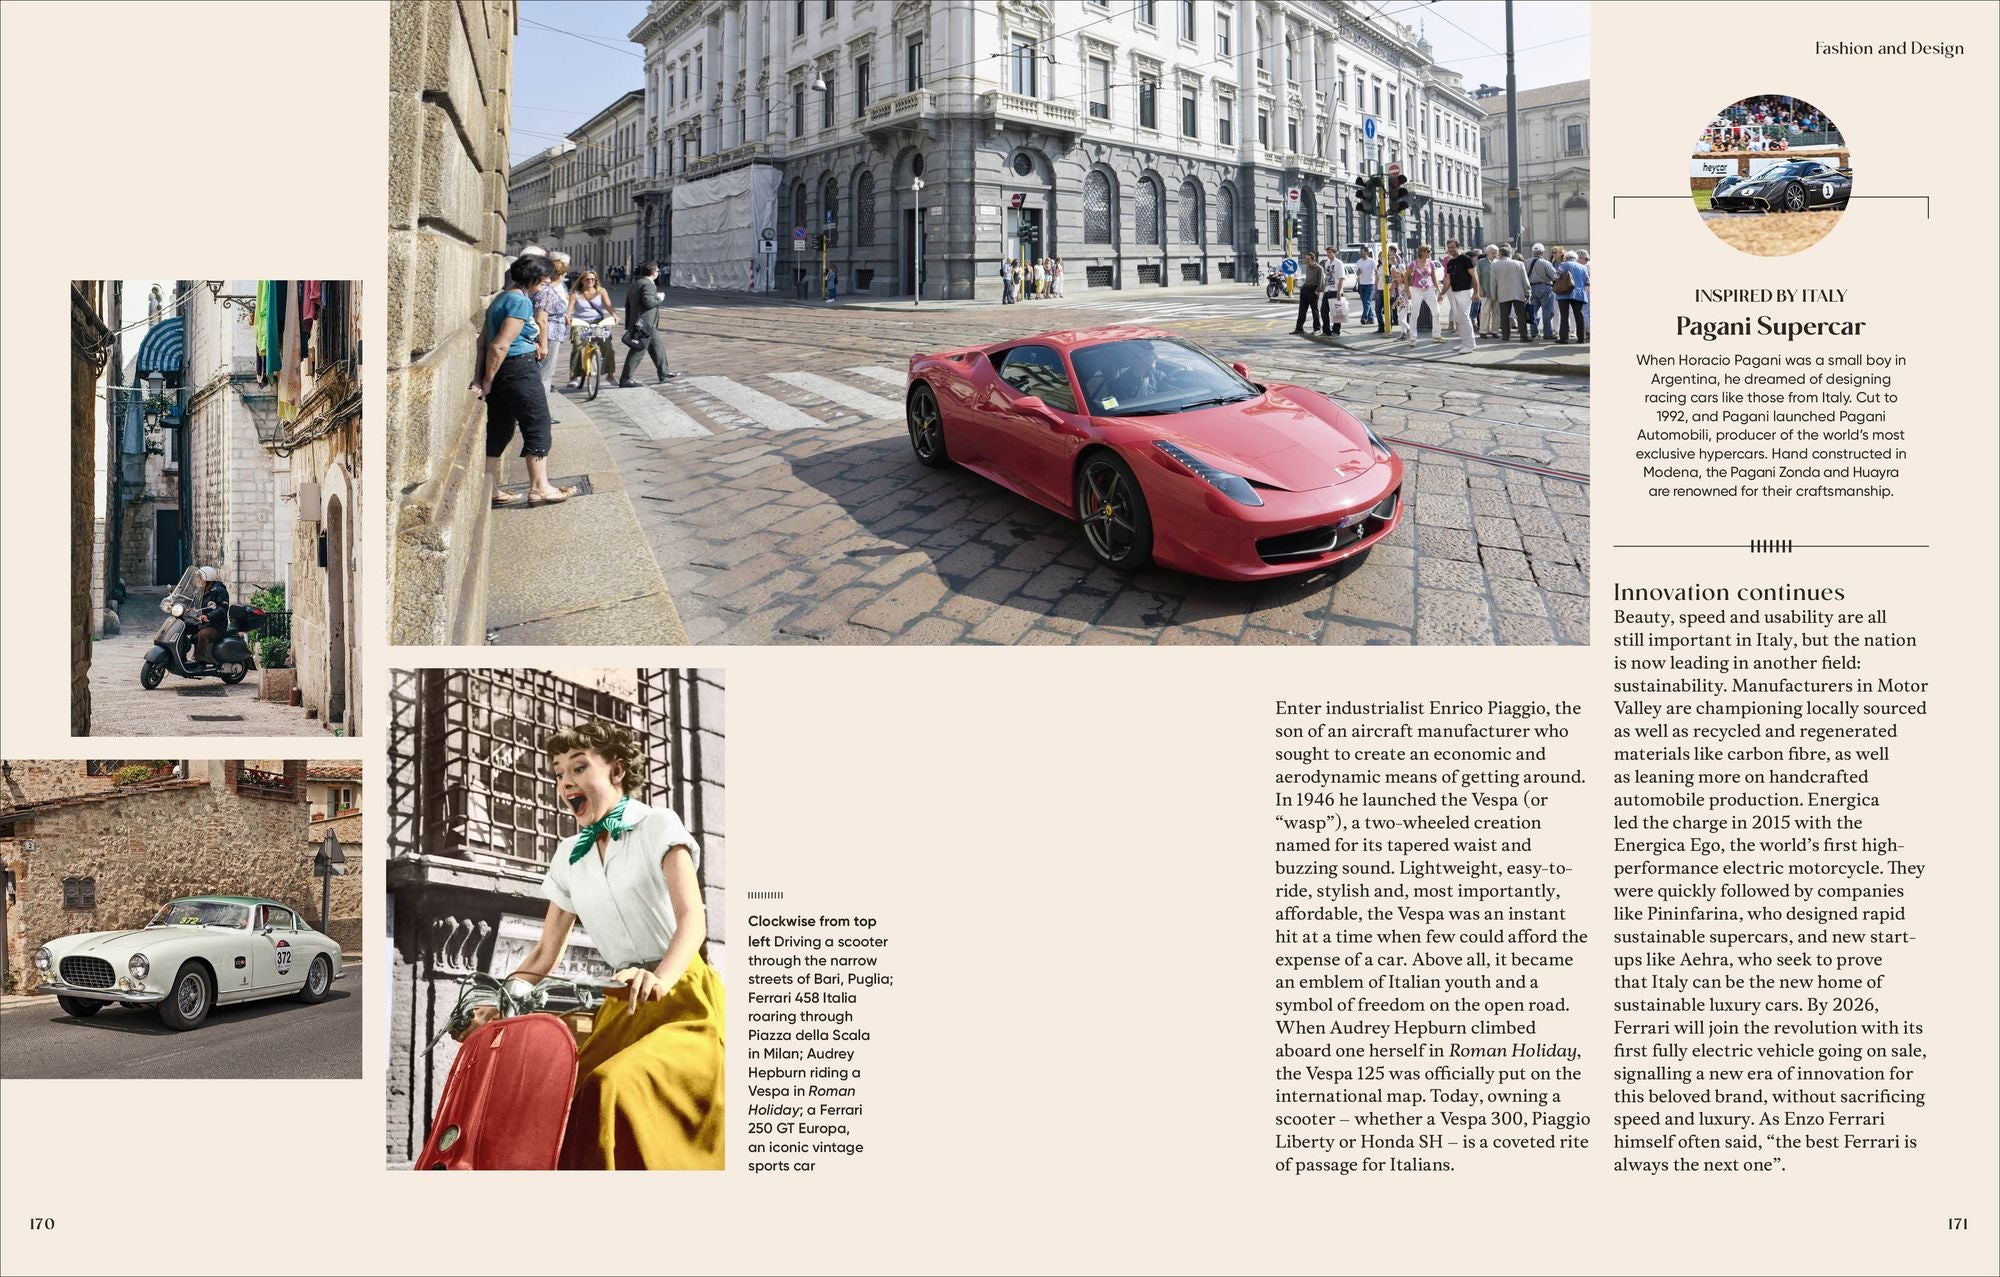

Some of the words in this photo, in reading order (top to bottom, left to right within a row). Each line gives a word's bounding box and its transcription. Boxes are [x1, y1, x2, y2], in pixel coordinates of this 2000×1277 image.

[1816, 41, 1873, 55] Fashion
[1878, 41, 1906, 54] and
[1911, 41, 1964, 58] Design
[1703, 162, 1728, 174] heycar
[1696, 289, 1773, 302] INSPIRED
[1777, 289, 1797, 302] BY
[1803, 289, 1847, 302] ITALY
[1677, 316, 1751, 341] Pagani
[1757, 315, 1866, 341] Supercar
[1636, 354, 1675, 366] When
[1679, 354, 1730, 366] Horacio
[1735, 354, 1781, 369] Pagani
[1785, 357, 1812, 366] was
[1815, 357, 1824, 366] a
[1828, 354, 1862, 366] small
[1866, 354, 1892, 368] boy
[1895, 354, 1906, 365] in
[1651, 373, 1720, 388] Argentina,
[1725, 373, 1741, 385] he
[1744, 373, 1805, 385] dreamed
[1809, 373, 1823, 384] of
[1826, 373, 1891, 388] designing
[1645, 392, 1686, 406] racing
[1690, 394, 1718, 403] cars
[1722, 391, 1744, 403] like
[1747, 392, 1785, 403] those
[1788, 391, 1818, 403] from
[1822, 391, 1852, 406] Italy.
[1856, 391, 1880, 403] Cut
[1884, 393, 1898, 403] to
[1656, 410, 1688, 424] 1992,
[1692, 411, 1718, 422] and
[1723, 410, 1769, 425] Pagani
[1773, 410, 1835, 422] launched
[1840, 410, 1885, 425] Pagani
[1637, 428, 1712, 442] Automobili,
[1716, 429, 1776, 443] producer
[1780, 429, 1794, 440] of
[1797, 429, 1819, 440] the
[1823, 429, 1869, 440] world’s
[1872, 430, 1905, 440] most
[1636, 448, 1695, 459] exclusive
[1699, 448, 1768, 462] hypercars.
[1772, 448, 1808, 459] Hand
[1812, 448, 1891, 459] constructed
[1896, 448, 1906, 459] in
[1644, 466, 1701, 479] Modena,
[1706, 466, 1727, 478] the
[1731, 466, 1775, 481] Pagani
[1779, 466, 1820, 478] Zonda
[1823, 466, 1849, 478] and
[1853, 466, 1899, 480] Huayra
[1649, 488, 1670, 497] are
[1673, 485, 1737, 497] renowned
[1741, 485, 1759, 497] for
[1762, 485, 1792, 497] their
[1796, 485, 1894, 499] craftsmanship.
[1615, 583, 1729, 601] Innovation
[1737, 583, 1845, 601] continues
[1614, 610, 1675, 628] Beauty,
[1679, 609, 1726, 628] speed
[1730, 610, 1760, 624] and
[1764, 609, 1834, 628] usability
[1838, 614, 1863, 624] are
[1868, 609, 1887, 624] all
[1614, 632, 1644, 646] still
[1649, 633, 1732, 651] important
[1736, 633, 1752, 646] in
[1756, 632, 1797, 651] Italy,
[1802, 632, 1829, 646] but
[1834, 632, 1859, 646] the
[1864, 633, 1917, 647] nation
[1614, 656, 1627, 669] is
[1631, 660, 1666, 669] now
[1670, 655, 1729, 674] leading
[1733, 656, 1749, 669] in
[1753, 655, 1818, 669] another
[1822, 655, 1861, 669] field:
[1276, 701, 1322, 715] Enter
[1326, 701, 1424, 715] industrialist
[1430, 701, 1483, 715] Enrico
[1488, 701, 1550, 719] Piaggio,
[1555, 701, 1581, 715] the
[1276, 728, 1303, 738] son
[1308, 723, 1326, 738] of
[1328, 728, 1347, 738] an
[1352, 723, 1413, 738] aircraft
[1418, 723, 1530, 738] manufacturer
[1534, 723, 1568, 738] who
[1276, 746, 1329, 765] sought
[1334, 749, 1350, 760] to
[1354, 749, 1406, 760] create
[1410, 751, 1429, 760] an
[1434, 747, 1511, 760] economic
[1516, 747, 1546, 760] and
[1275, 769, 1381, 788] aerodynamic
[1385, 774, 1437, 783] means
[1442, 769, 1460, 783] of
[1461, 770, 1520, 788] getting
[1523, 769, 1585, 783] around.
[748, 915, 816, 927] Clockwise
[819, 915, 850, 927] from
[853, 916, 877, 929] top
[748, 935, 771, 947] left
[774, 936, 821, 950] Driving
[825, 938, 834, 947] a
[838, 937, 888, 947] scooter
[277, 951, 291, 964] 372
[748, 955, 801, 969] through
[804, 955, 827, 966] the
[831, 957, 877, 966] narrow
[748, 974, 793, 984] streets
[797, 973, 811, 984] of
[814, 973, 844, 986] Bari,
[848, 973, 893, 987] Puglia;
[749, 992, 791, 1003] Ferrari
[795, 992, 819, 1003] 458
[823, 992, 856, 1003] Italia
[748, 1010, 796, 1025] roaring
[800, 1010, 853, 1025] through
[749, 1029, 791, 1041] Piazza
[795, 1029, 829, 1041] della
[832, 1029, 870, 1041] Scala
[748, 1048, 760, 1059] in
[764, 1047, 803, 1061] Milan;
[807, 1048, 854, 1062] Audrey
[749, 1067, 806, 1081] Hepburn
[810, 1067, 848, 1081] riding
[852, 1069, 860, 1078] a
[748, 1085, 789, 1099] Vespa
[794, 1085, 805, 1096] in
[808, 1085, 855, 1096] Roman
[748, 1104, 803, 1118] Holiday;
[807, 1107, 816, 1115] a
[820, 1104, 862, 1115] Ferrari
[748, 1122, 773, 1134] 250
[776, 1122, 795, 1134] GT
[799, 1122, 850, 1136] Europa,
[748, 1144, 765, 1153] an
[769, 1141, 809, 1153] iconic
[812, 1141, 864, 1156] vintage
[748, 1161, 790, 1174] sports
[793, 1162, 816, 1171] car
[30, 1218, 55, 1230] 170
[1949, 1218, 1967, 1230] 171
